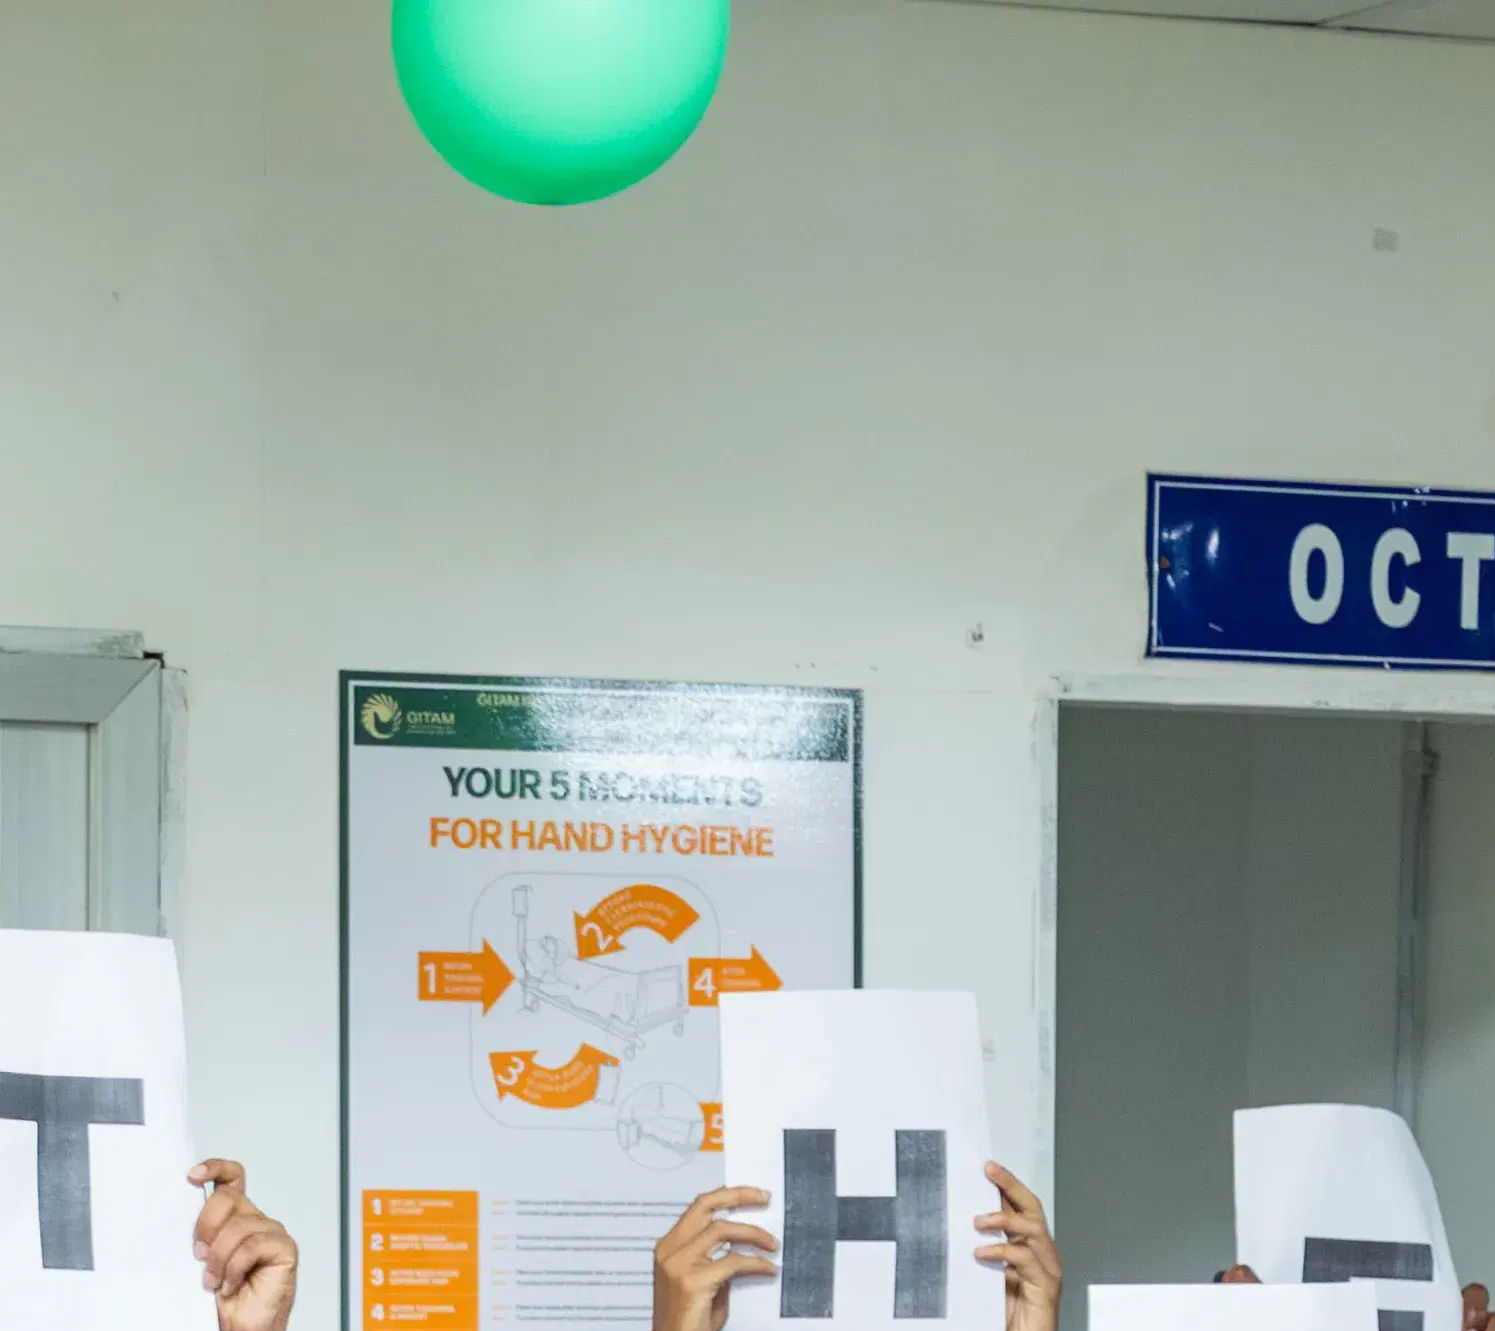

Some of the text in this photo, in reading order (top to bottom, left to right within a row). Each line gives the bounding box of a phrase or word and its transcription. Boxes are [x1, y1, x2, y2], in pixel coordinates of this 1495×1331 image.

[406, 711, 457, 727] GITAM
[443, 765, 764, 808] YOUR 5 MOMENTS
[429, 817, 775, 857] FOR HAND HYGIENE
[580, 922, 614, 951] 2
[423, 963, 437, 995] 1
[693, 967, 717, 999] 4
[496, 1056, 525, 1087] 3
[371, 1197, 382, 1217] 1
[780, 1129, 948, 1319] H
[369, 1267, 385, 1287] 3
[370, 1303, 385, 1322] 4
